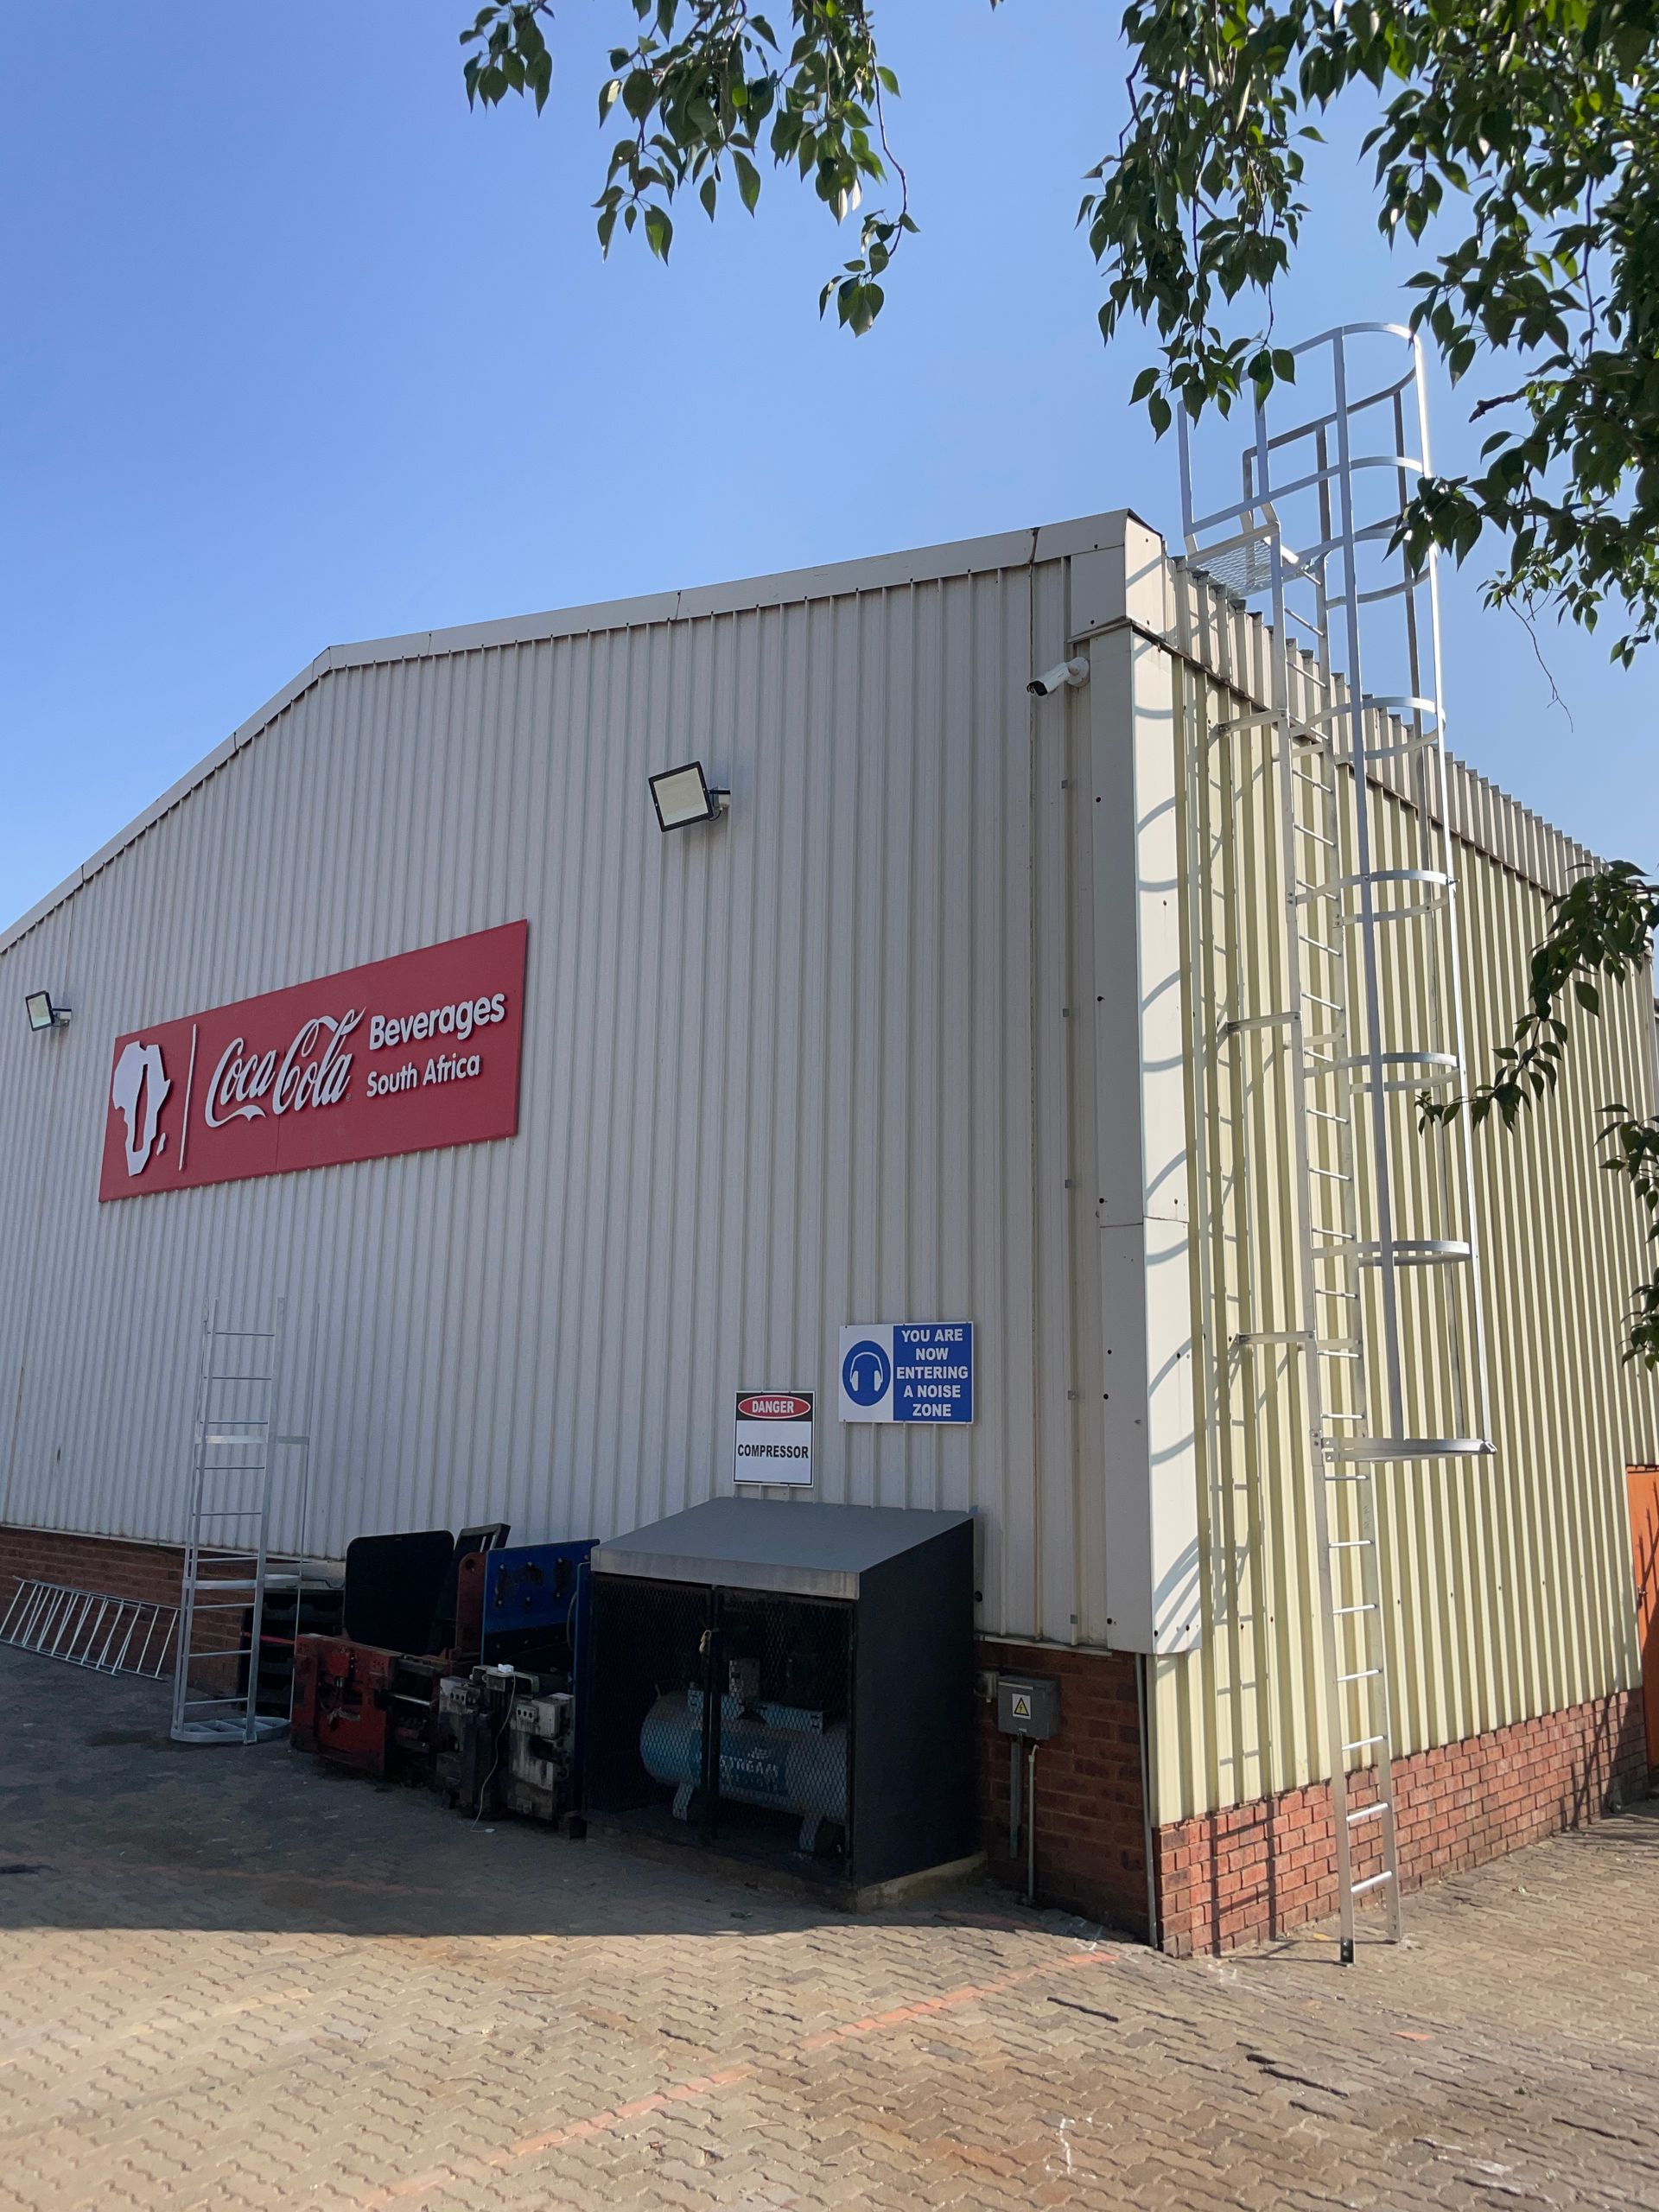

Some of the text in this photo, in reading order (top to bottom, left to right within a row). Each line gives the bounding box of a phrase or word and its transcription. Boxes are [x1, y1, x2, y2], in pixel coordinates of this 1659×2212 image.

[369, 993, 505, 1051] Beverages
[366, 1052, 480, 1097] South Africa
[901, 1328, 963, 1343] YOU ARE
[916, 1347, 949, 1361] NOW
[896, 1366, 969, 1380] ENTERING
[903, 1385, 962, 1398] A NOISE
[752, 1400, 795, 1414] DANGER
[912, 1403, 951, 1417] ZONE
[737, 1444, 810, 1459] COMPRESSOR
